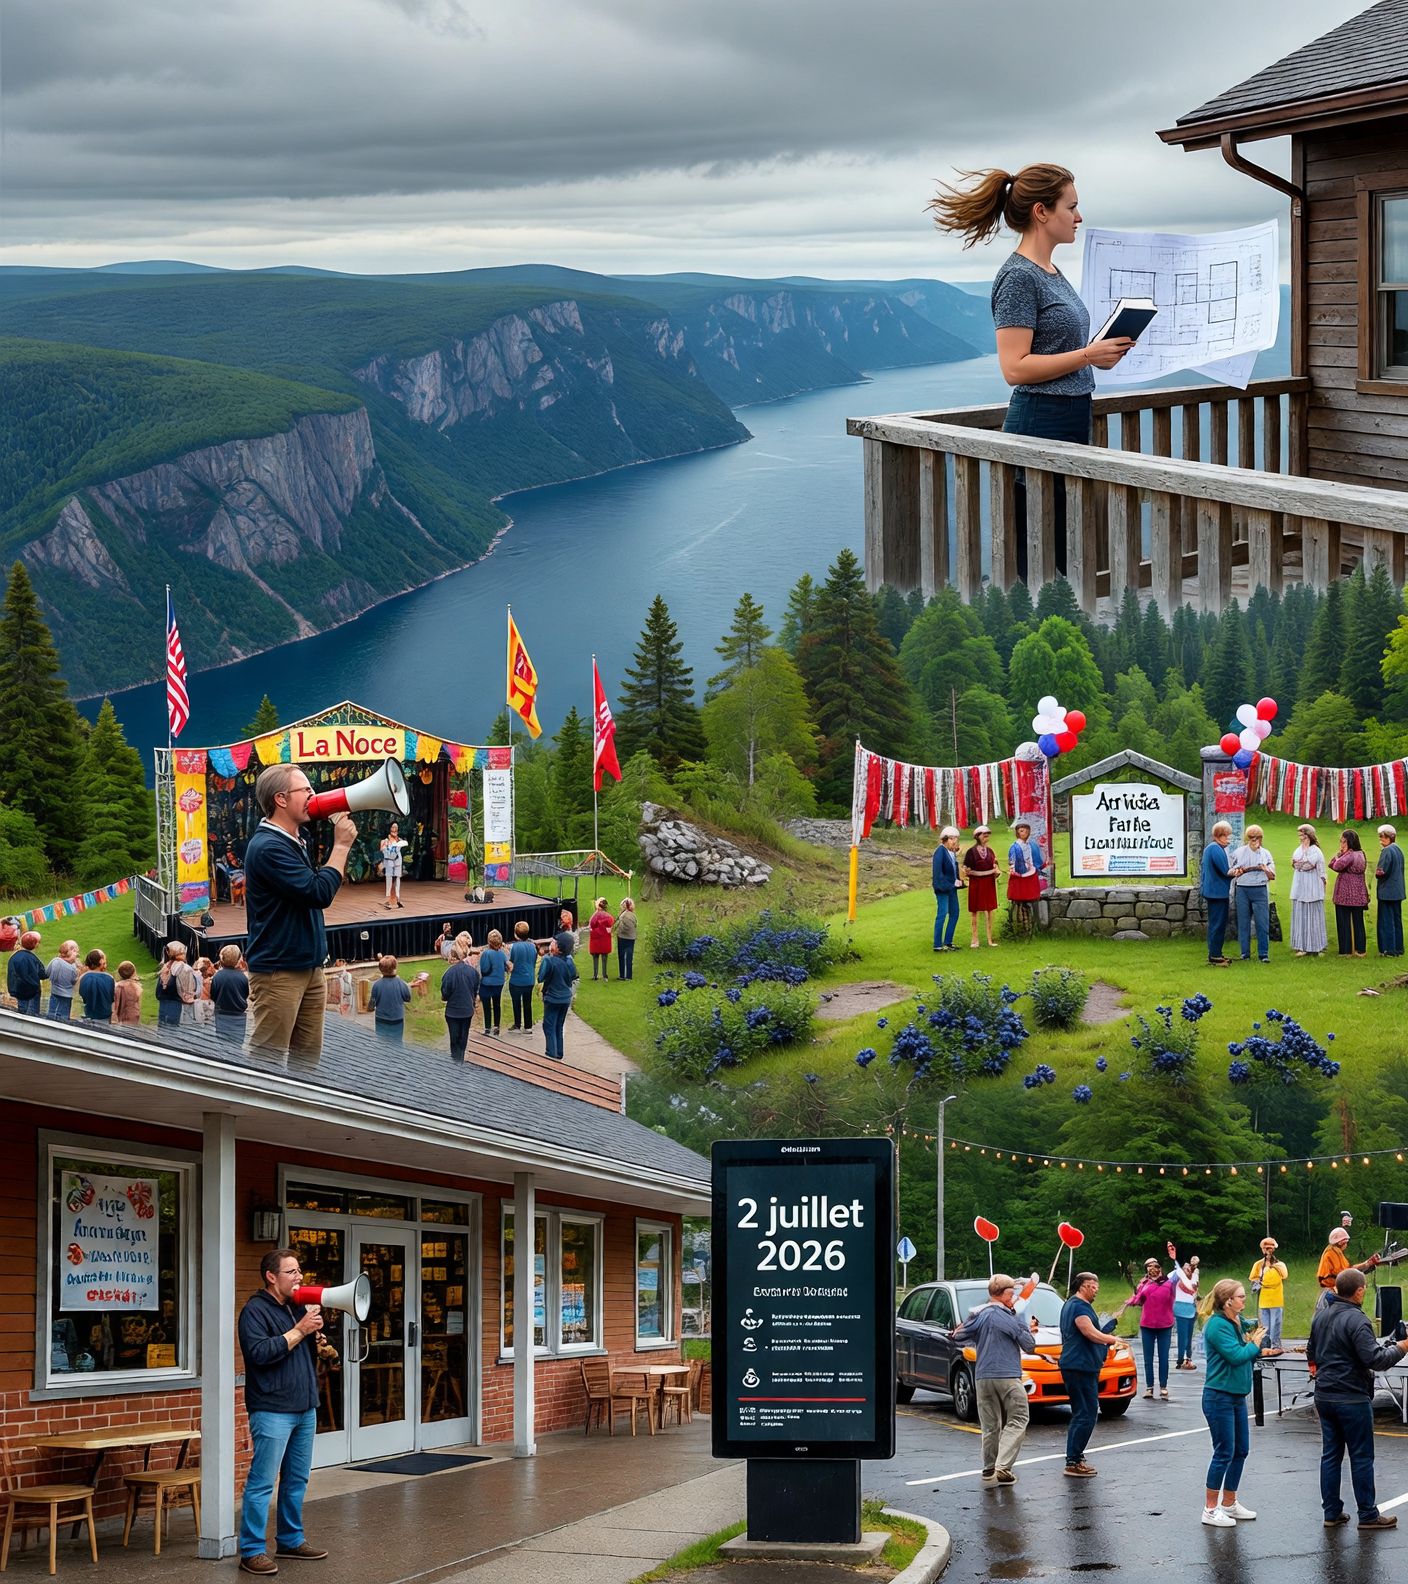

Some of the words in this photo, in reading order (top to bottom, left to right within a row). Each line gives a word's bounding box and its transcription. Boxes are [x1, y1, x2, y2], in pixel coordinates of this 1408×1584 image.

[297, 731, 329, 758] La
[336, 729, 399, 757] Noce
[737, 1197, 759, 1229] 2
[764, 1195, 864, 1237] juillet
[756, 1239, 846, 1271] 2026
